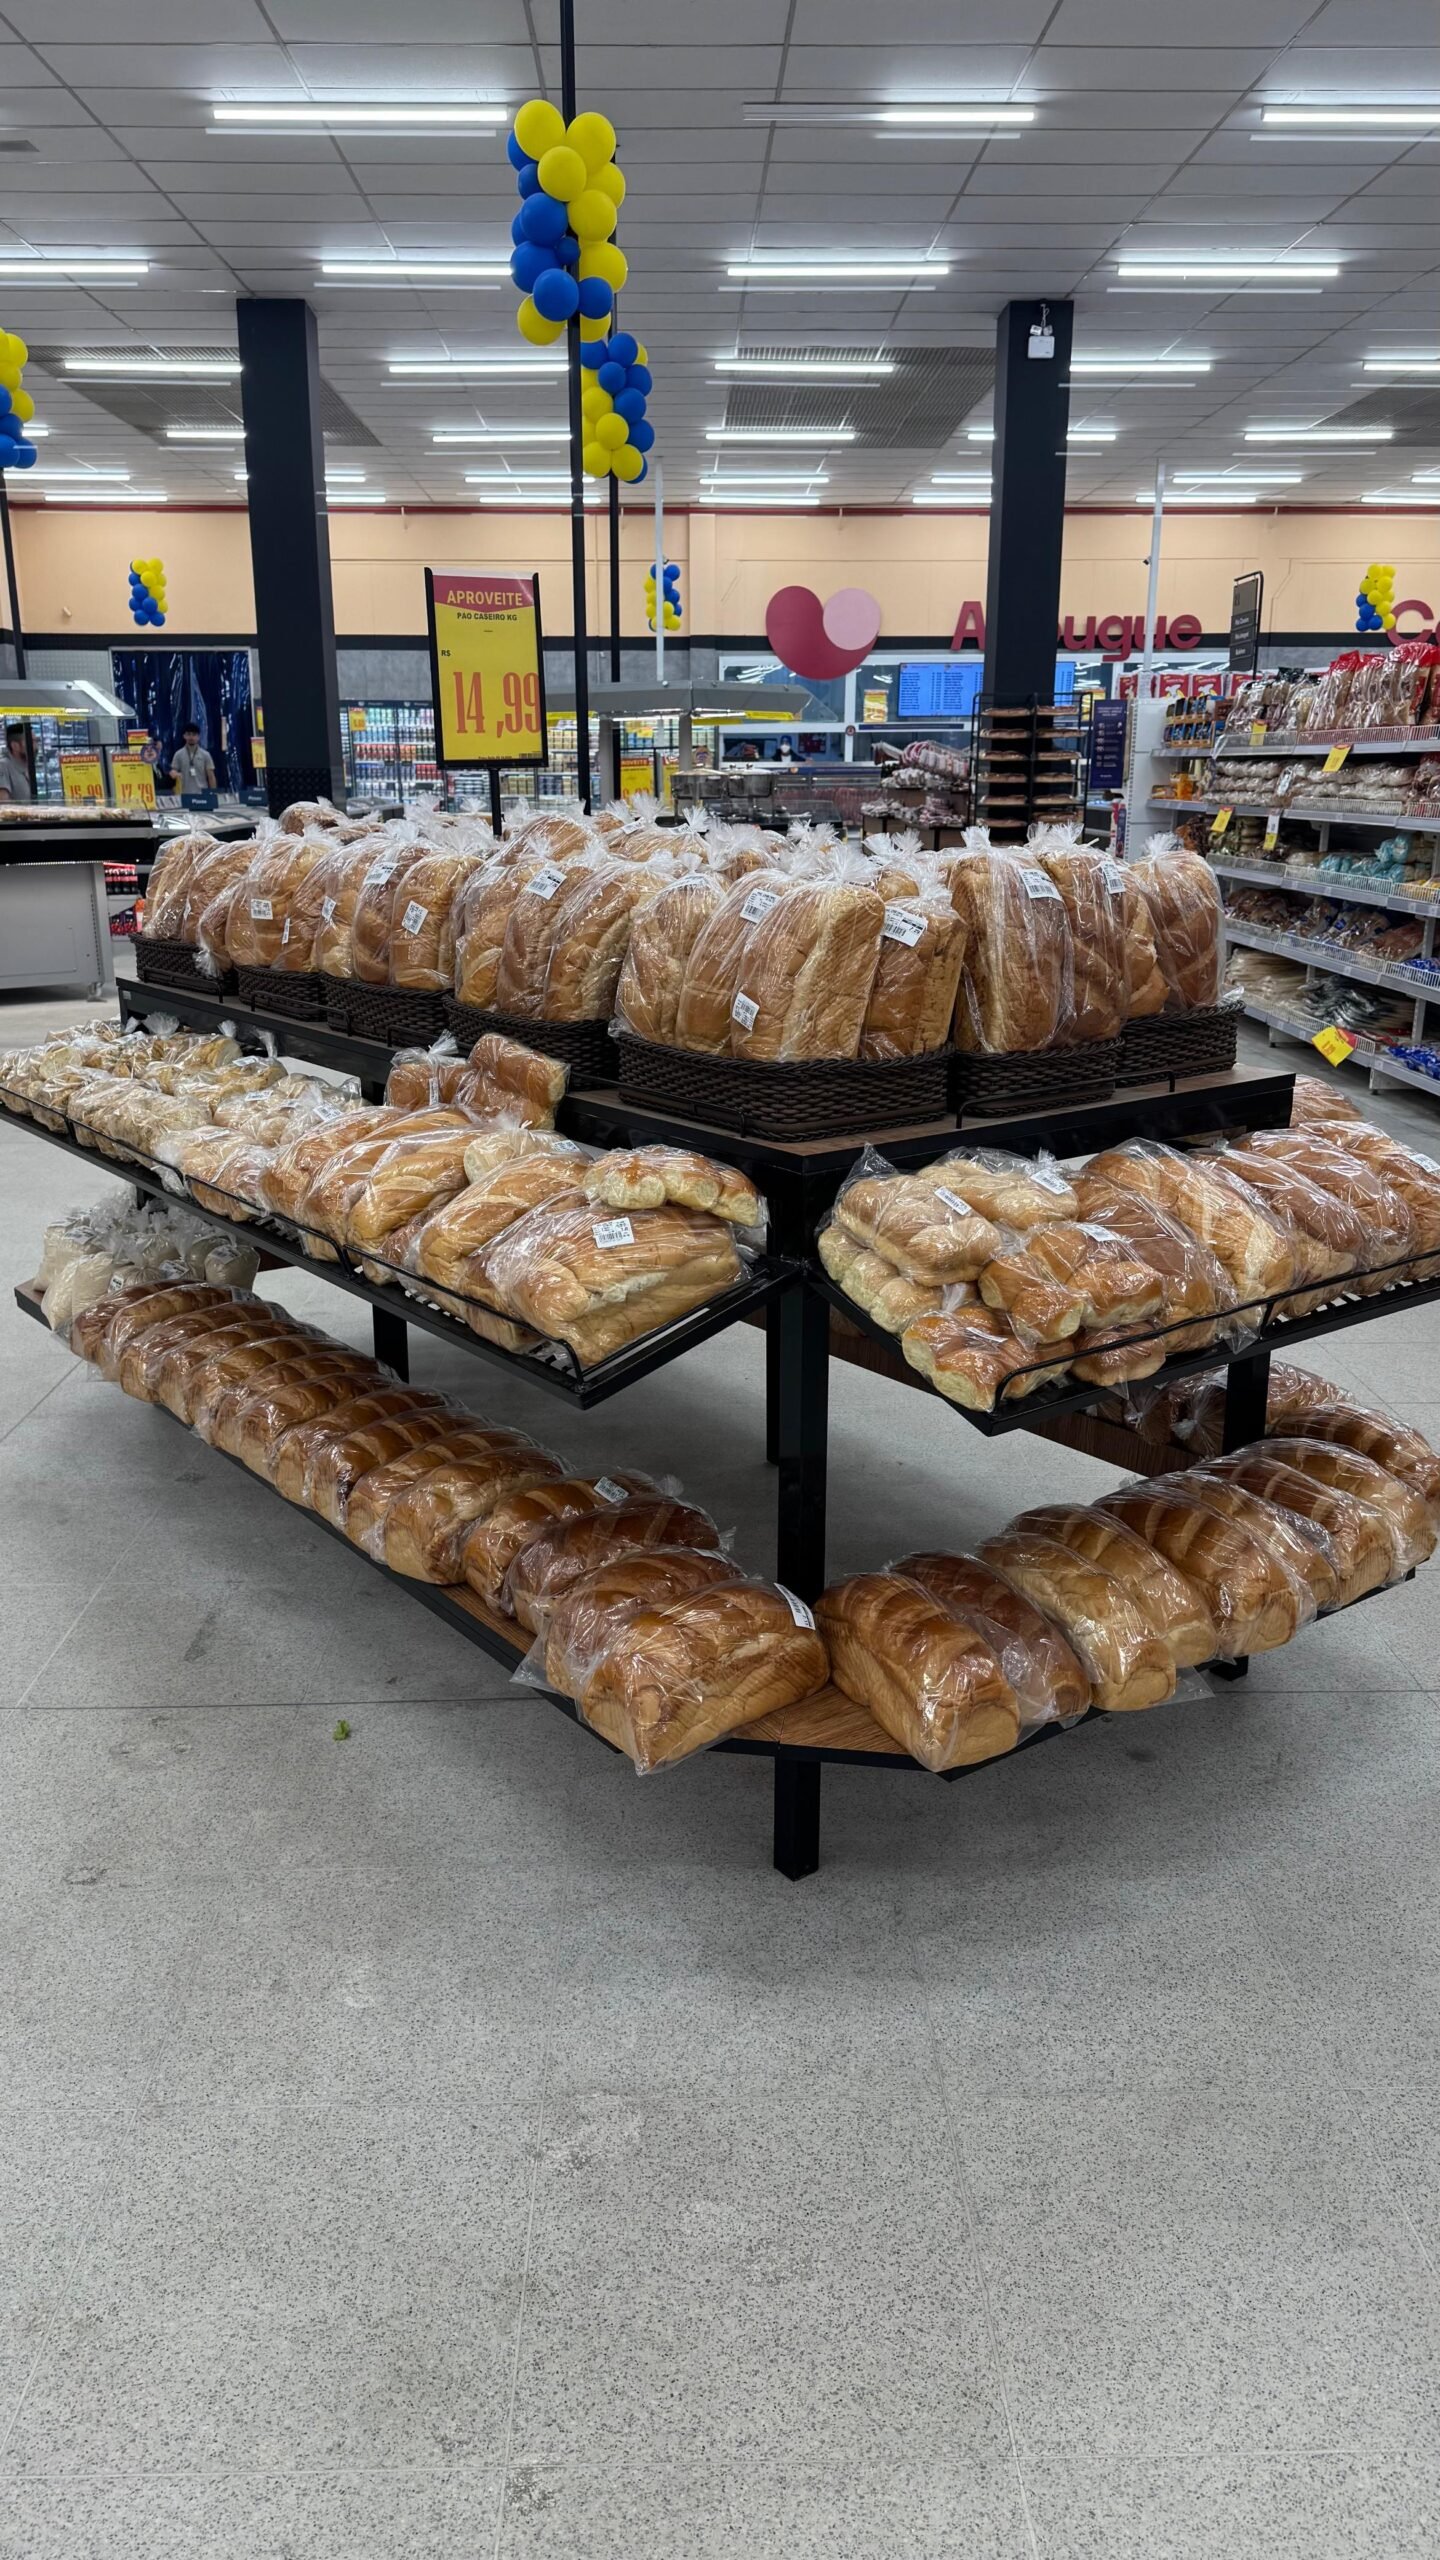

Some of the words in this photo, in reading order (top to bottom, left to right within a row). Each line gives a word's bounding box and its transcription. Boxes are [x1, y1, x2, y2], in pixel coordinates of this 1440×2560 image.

[446, 590, 523, 606] APROVEITE
[457, 612, 472, 620] PAO
[474, 613, 505, 621] CASEIRO
[951, 601, 1202, 662] Augue
[62, 755, 98, 763] APROVEITE
